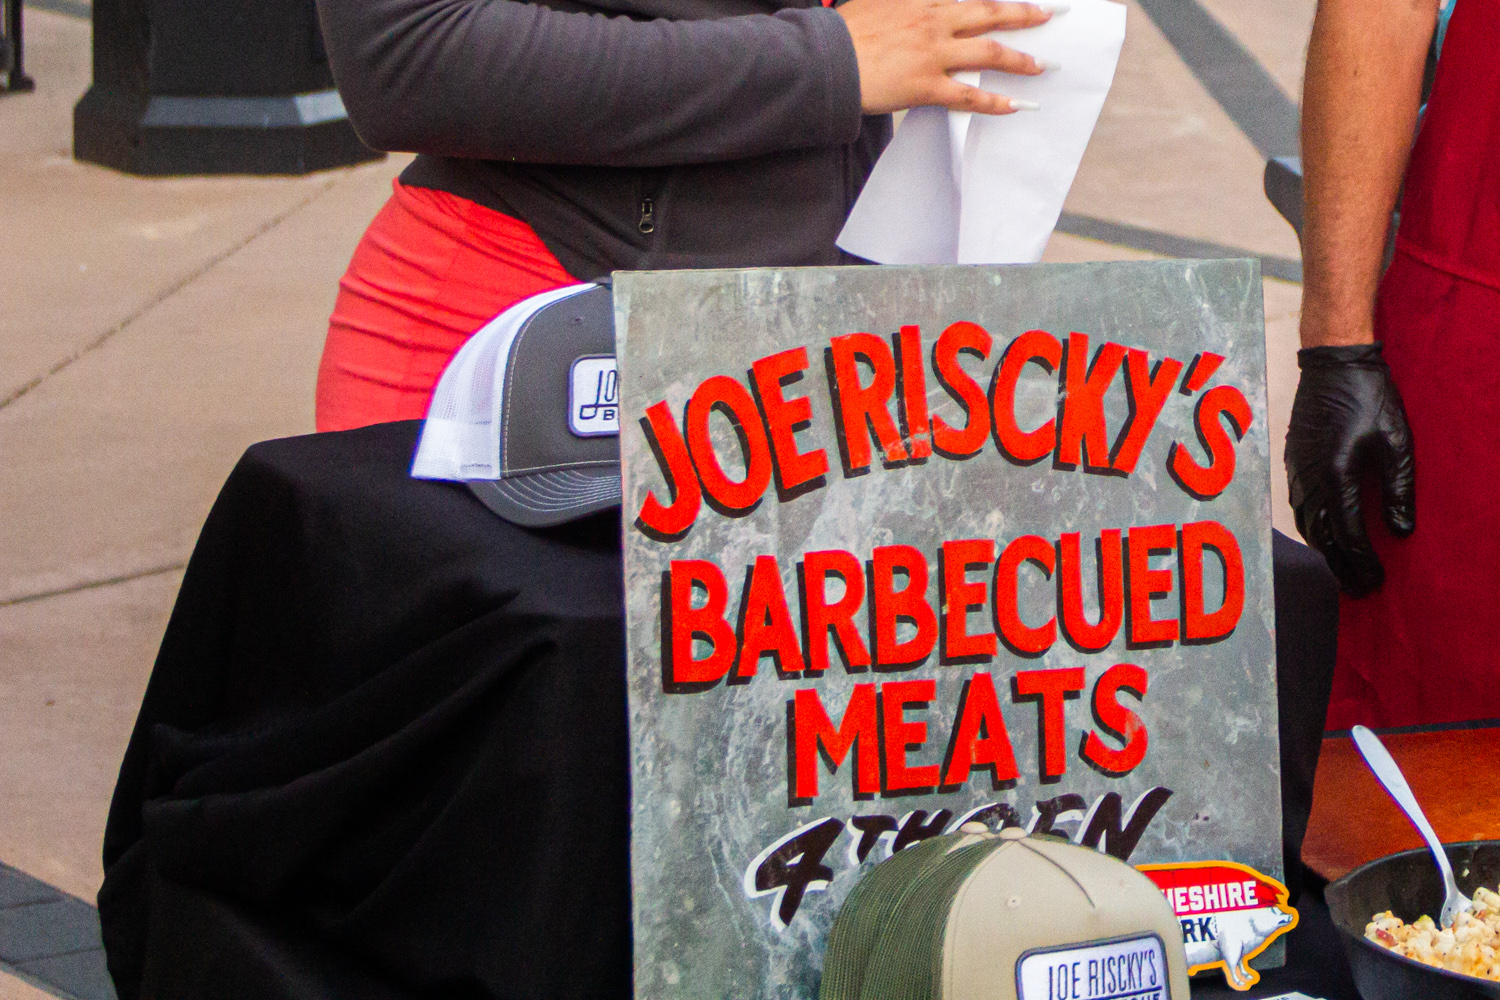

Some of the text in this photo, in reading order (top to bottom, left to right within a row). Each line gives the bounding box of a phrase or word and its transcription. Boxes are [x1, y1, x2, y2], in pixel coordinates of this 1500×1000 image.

[634, 320, 1254, 542] JOE RISCKY'S
[661, 519, 1246, 695] BARBECUED
[787, 663, 1150, 807] MEATS
[1048, 948, 1157, 1000] JOE RISCKY'S
